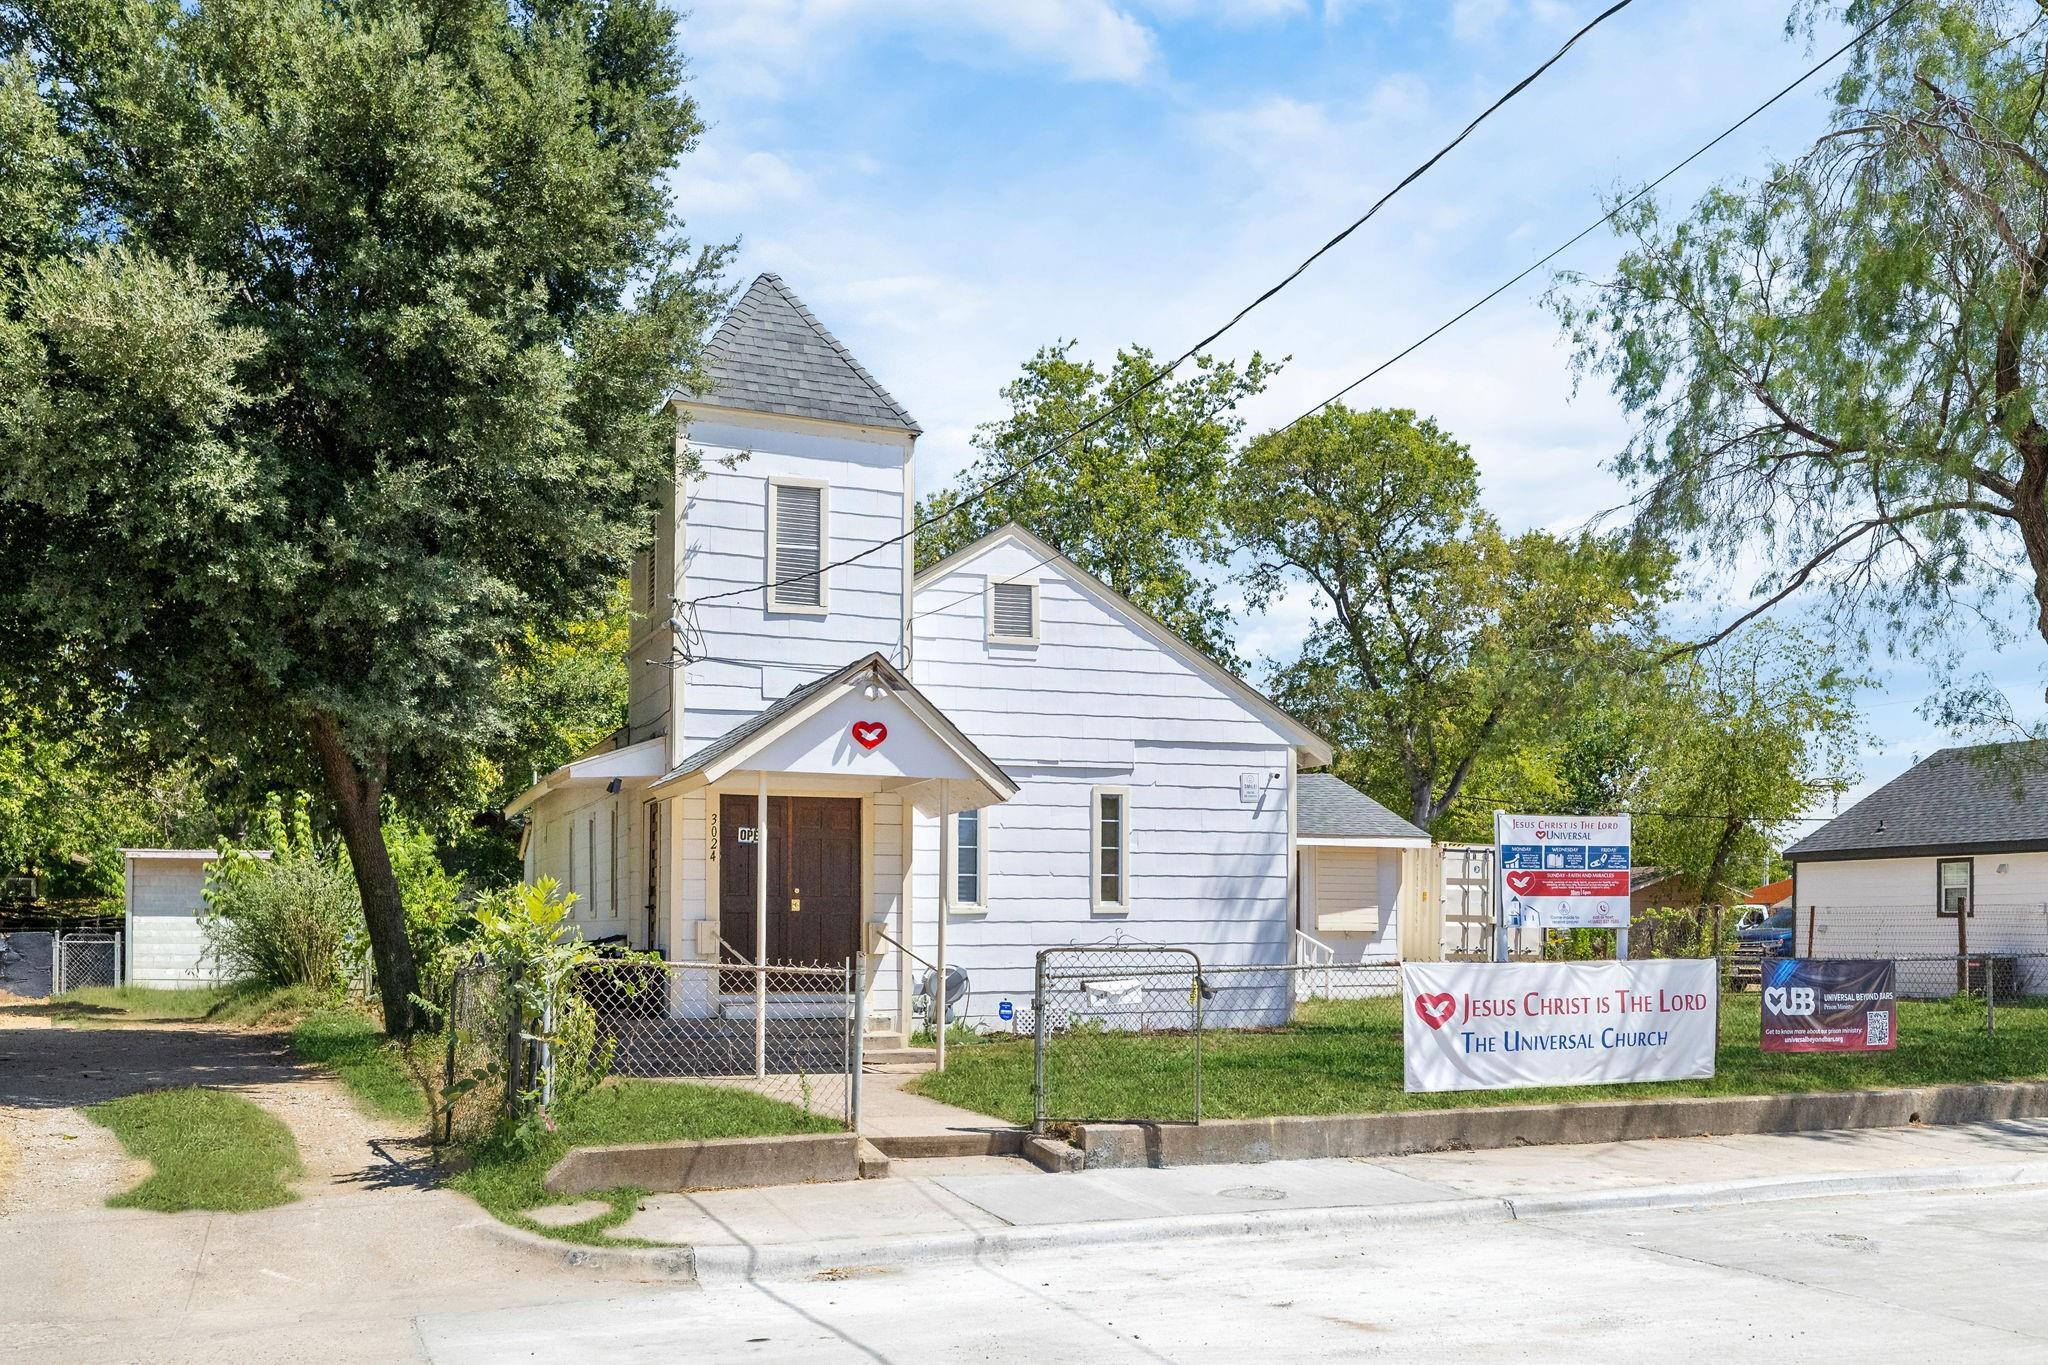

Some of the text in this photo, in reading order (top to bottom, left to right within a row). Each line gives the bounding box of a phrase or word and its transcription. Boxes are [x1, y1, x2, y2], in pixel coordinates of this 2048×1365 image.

[1512, 819, 1535, 830] JESUS
[1538, 820, 1567, 829] CHRIST
[1581, 821, 1594, 829] THE
[1598, 821, 1619, 829] LORD
[740, 830, 758, 841] OPE
[1546, 831, 1592, 840] UNIVERSAL
[1824, 993, 1855, 1002] UNIVERSAL
[1856, 992, 1879, 1001] BEYOND
[1462, 989, 1707, 1025] JESUS CHRIST IS THE LORD
[1461, 1028, 1668, 1054] THE UNIVERSAL CHURCH
